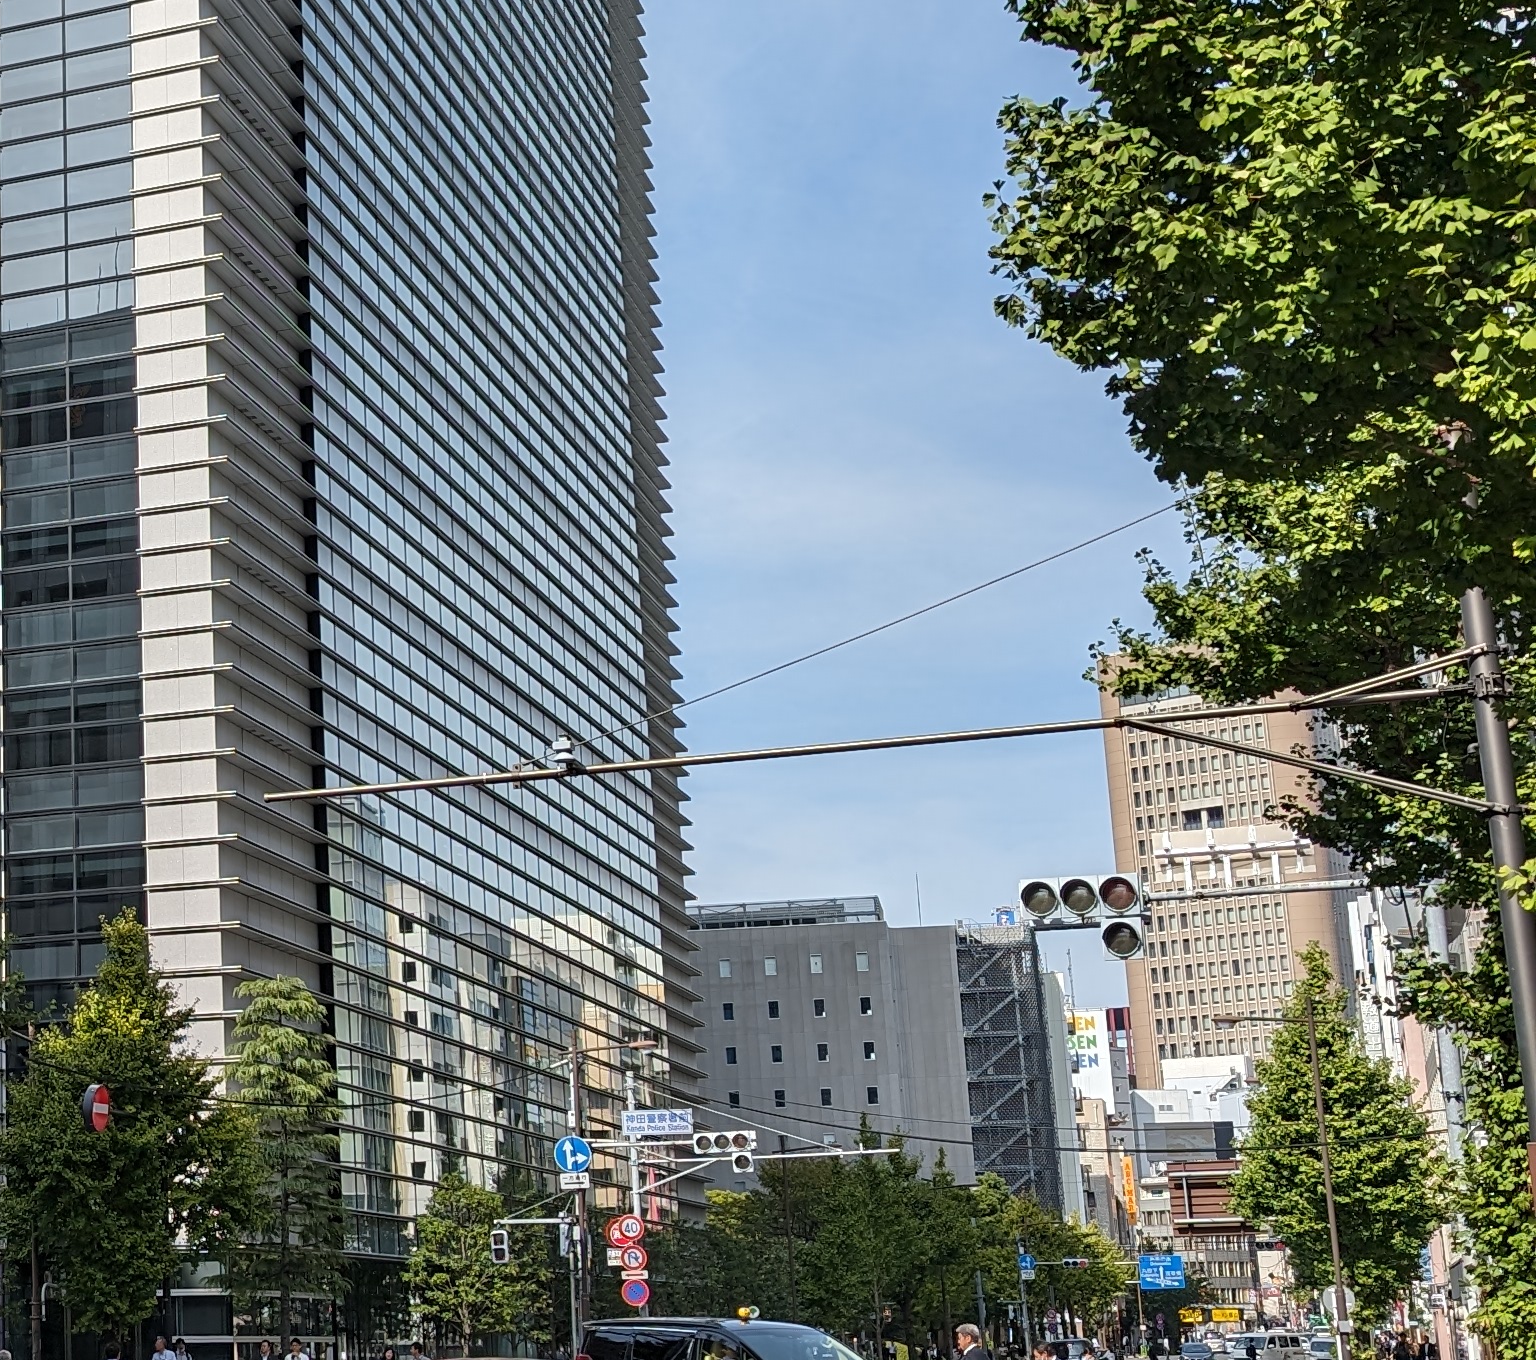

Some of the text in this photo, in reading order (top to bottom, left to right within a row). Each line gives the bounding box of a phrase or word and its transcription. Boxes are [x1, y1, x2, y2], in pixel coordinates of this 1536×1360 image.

[647, 1124, 666, 1132] Police
[667, 1123, 690, 1132] Station
[624, 1221, 639, 1235] 40
